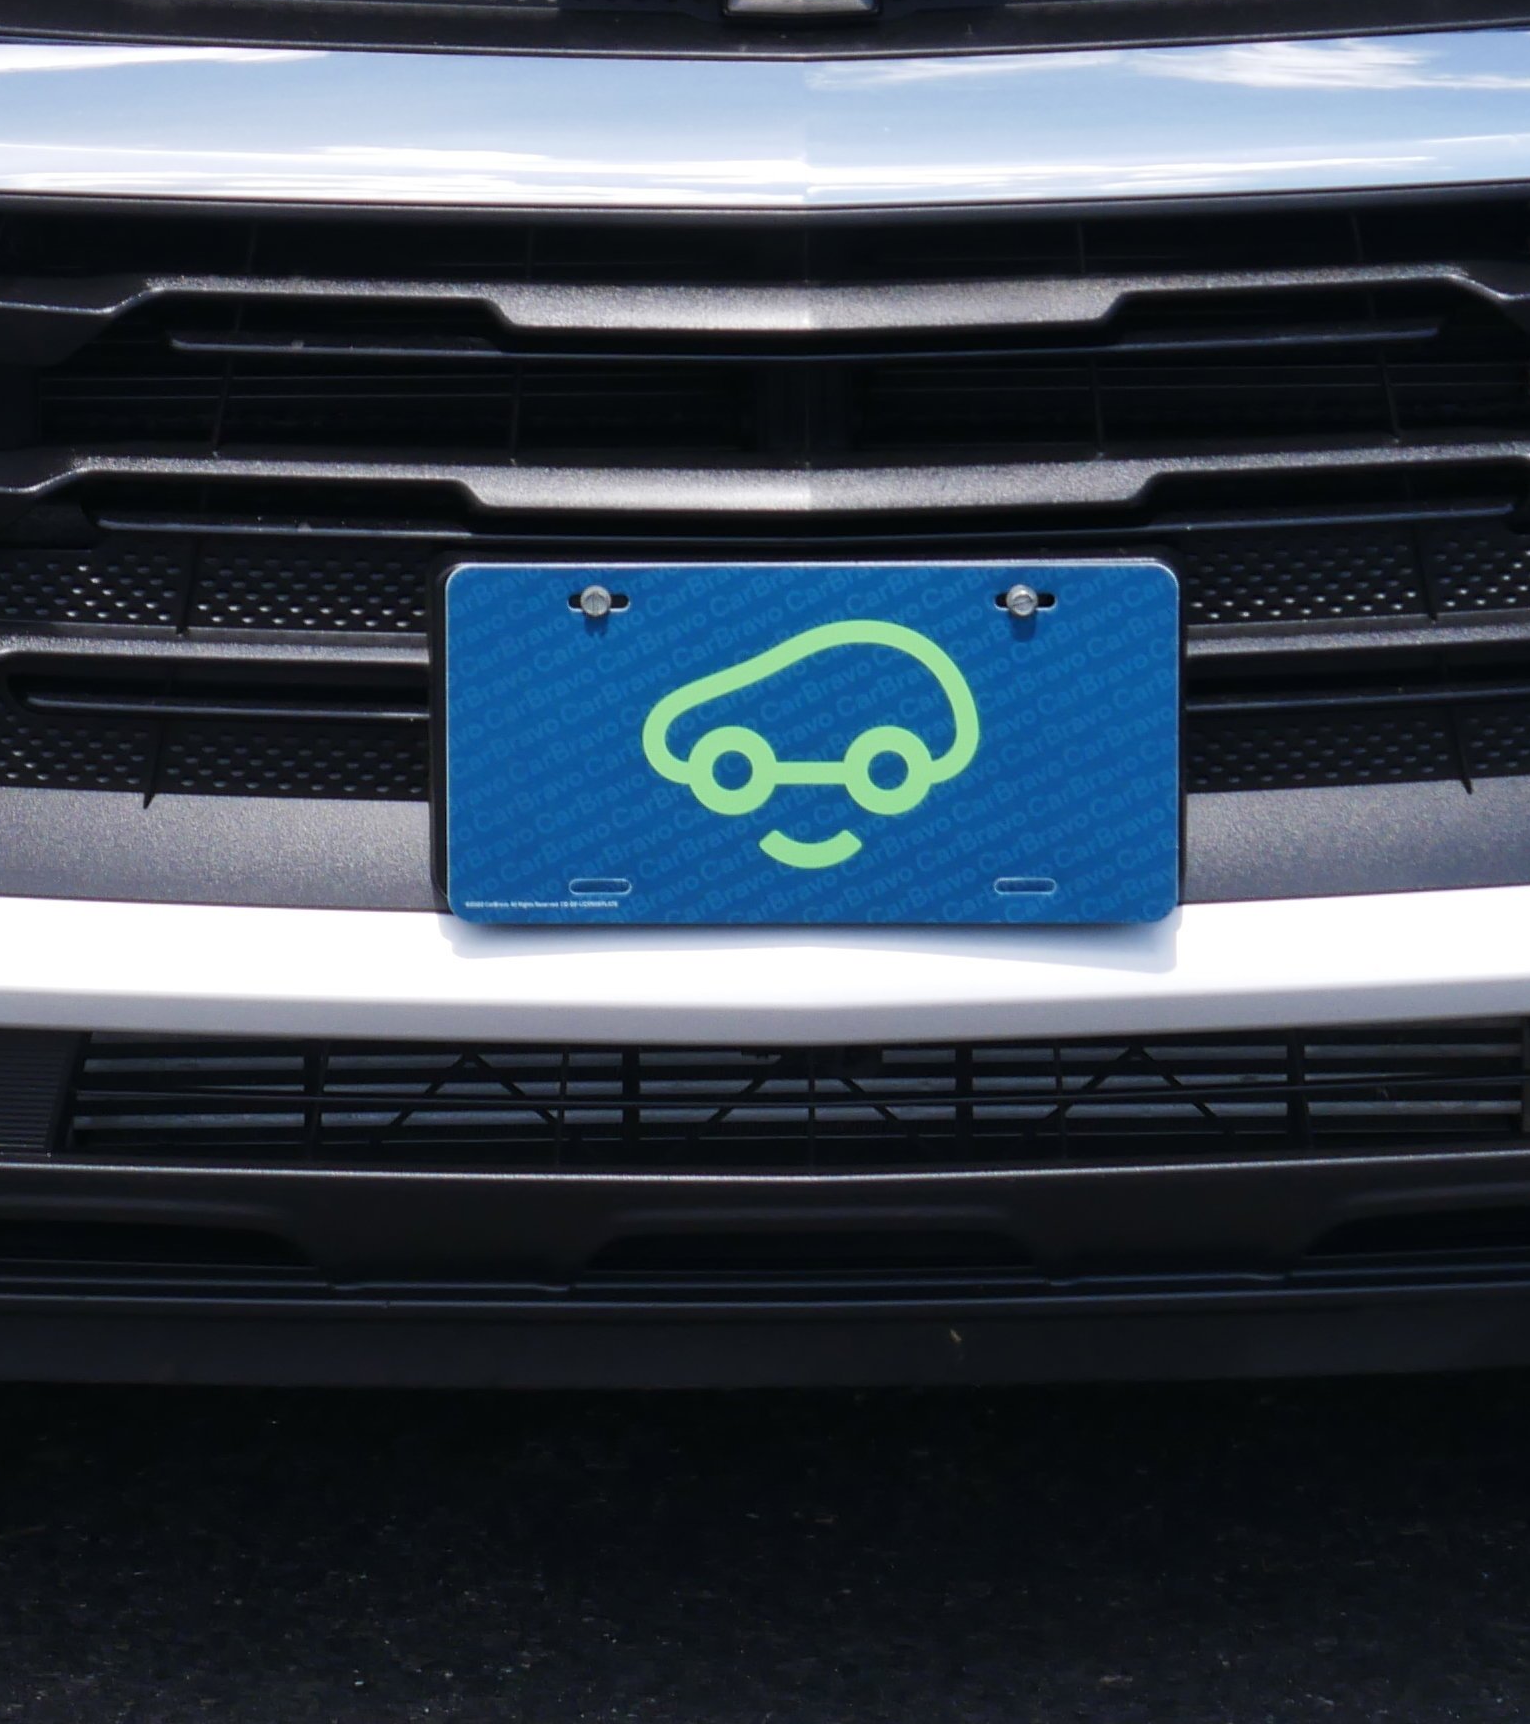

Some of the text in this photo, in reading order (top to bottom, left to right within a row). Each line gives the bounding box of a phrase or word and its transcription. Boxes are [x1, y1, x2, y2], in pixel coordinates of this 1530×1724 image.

[449, 569, 543, 623] arBravo
[506, 570, 618, 621] CarBrav
[707, 568, 818, 619] CarBrav
[783, 568, 880, 614] CarBra
[898, 657, 1011, 720] Caravo
[585, 714, 698, 777] CarBvo
[724, 710, 837, 773] CBravo
[1089, 767, 1176, 820] CarBra
[700, 820, 813, 883] CarBvo
[1079, 862, 1176, 922] CarBrav
